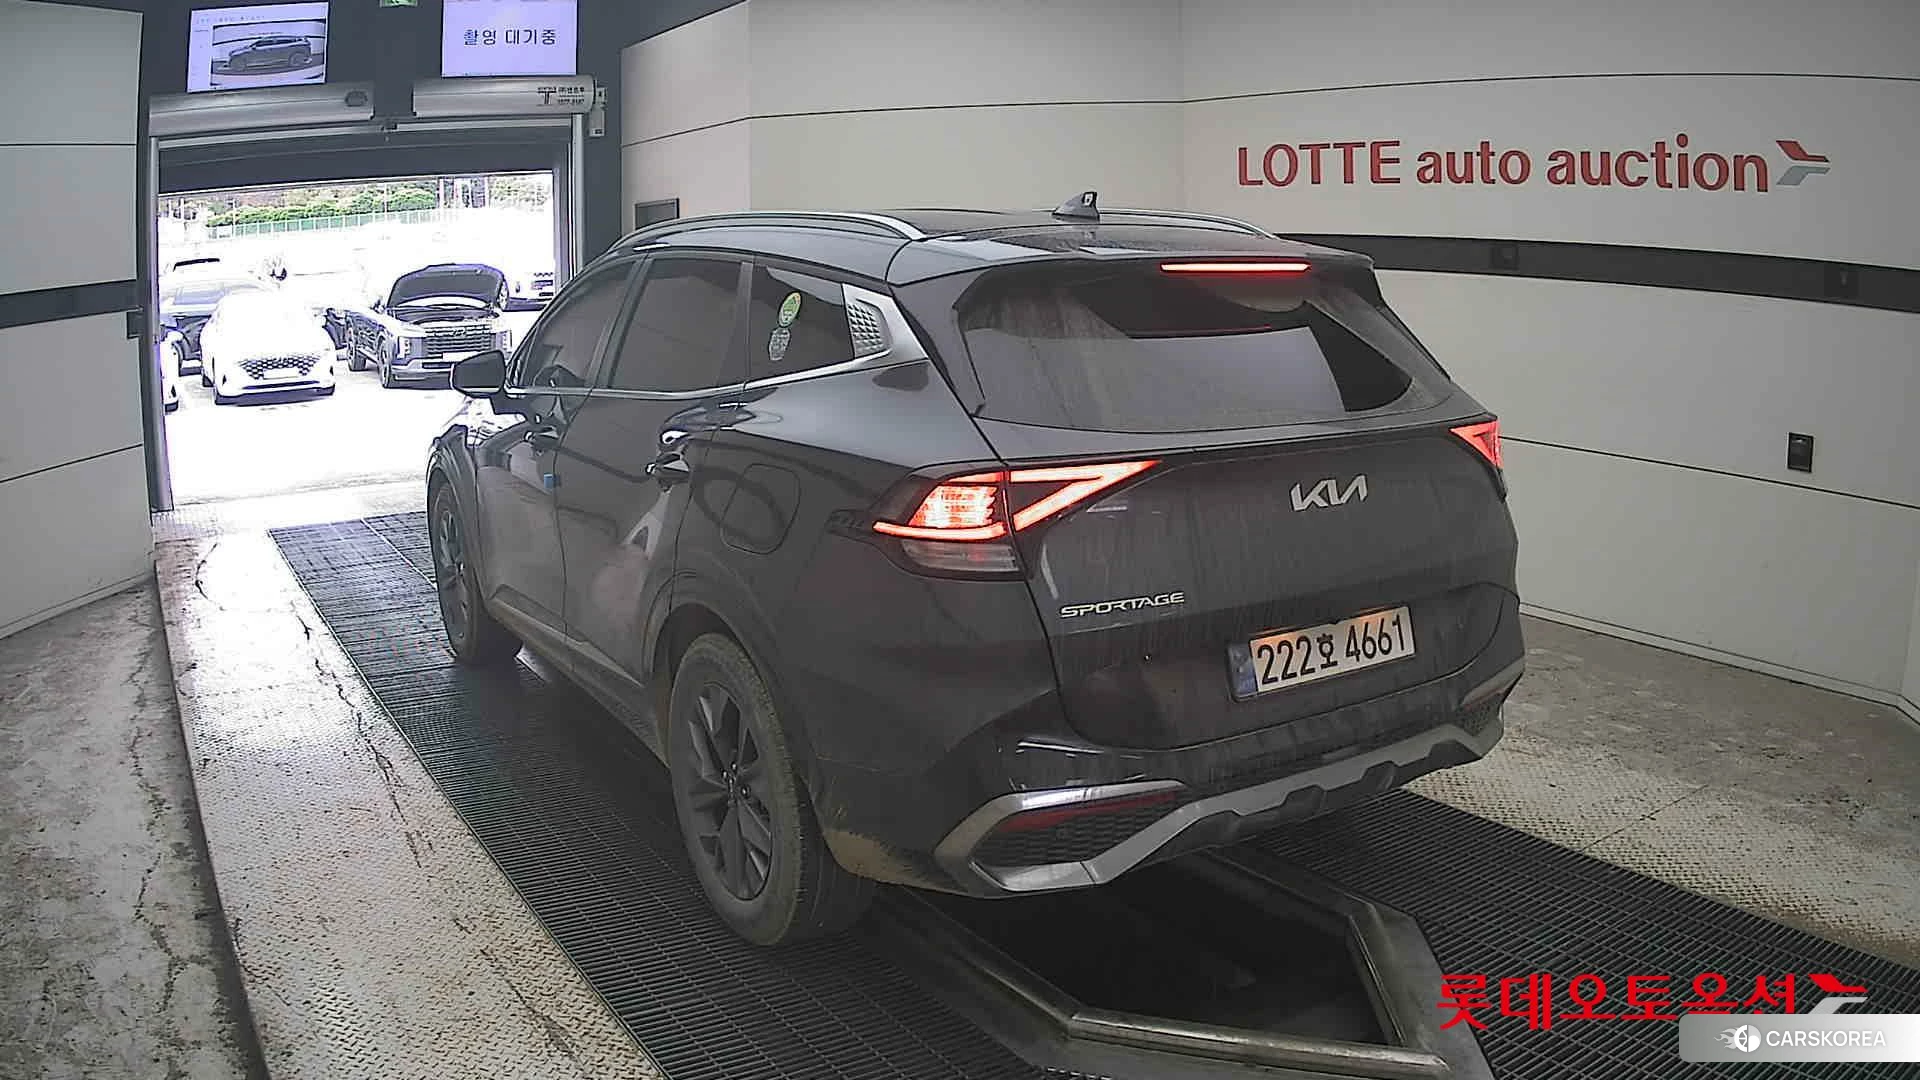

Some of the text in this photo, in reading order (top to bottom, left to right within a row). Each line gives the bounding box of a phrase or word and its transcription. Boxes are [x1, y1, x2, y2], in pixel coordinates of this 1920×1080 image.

[505, 29, 556, 45] 대기중
[1238, 133, 1769, 193] LOTTE auto auction
[1290, 474, 1368, 511] KIA
[1060, 591, 1185, 618] SPORTAGE
[1257, 613, 1405, 685] 222호 4661
